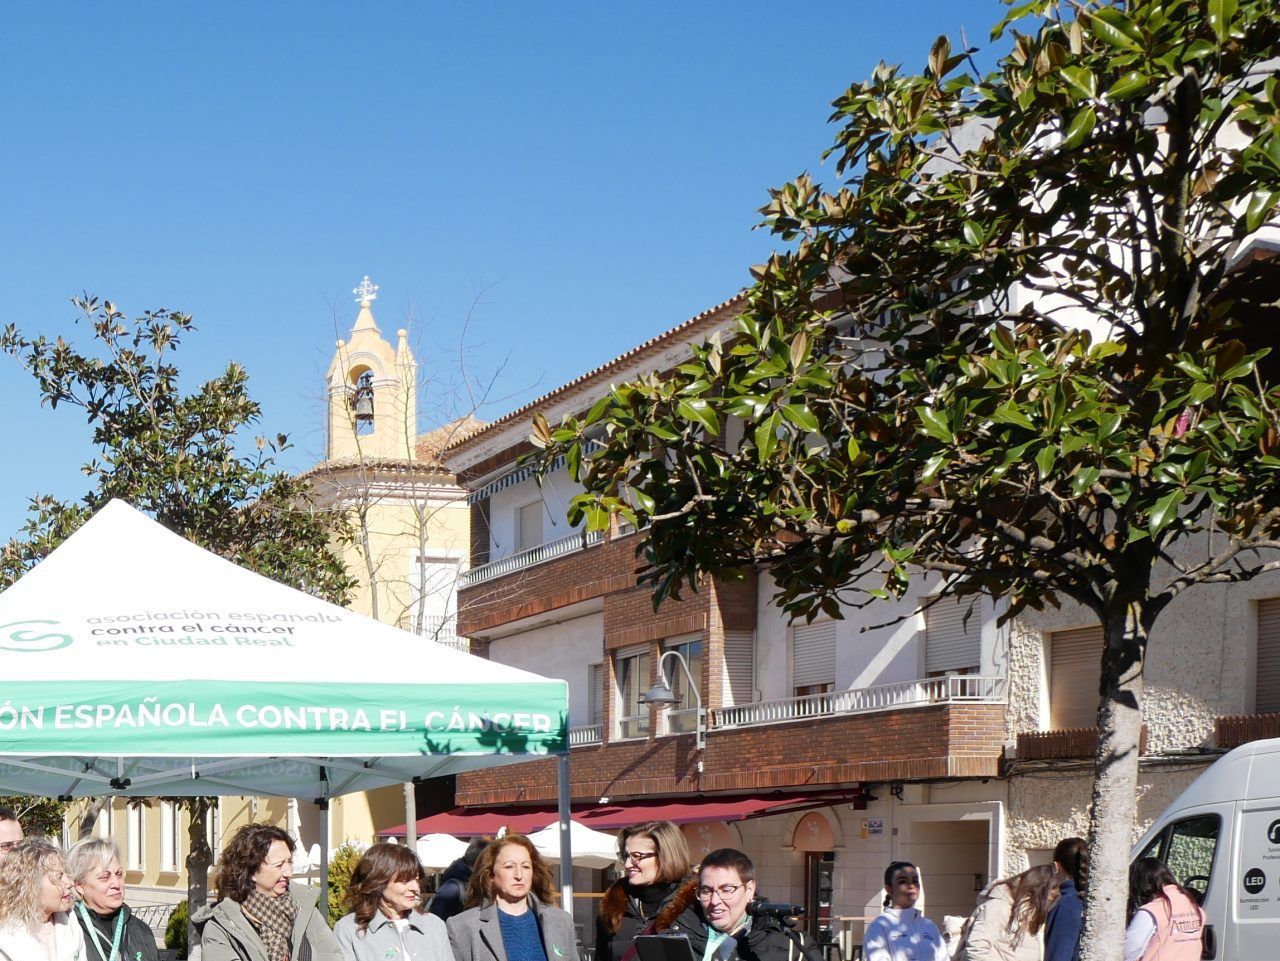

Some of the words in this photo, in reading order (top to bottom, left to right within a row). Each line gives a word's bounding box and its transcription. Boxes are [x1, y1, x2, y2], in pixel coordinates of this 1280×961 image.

[86, 610, 221, 625] asociación
[91, 624, 174, 636] contra
[181, 622, 203, 633] el
[210, 623, 296, 635] cáncer
[135, 636, 232, 646] Ciudad
[234, 637, 294, 646] Real
[54, 697, 231, 729] ESPAÑOLA
[236, 704, 372, 732] CONTRA
[379, 709, 416, 732] EL
[424, 705, 552, 733] CÁNCER
[1245, 876, 1264, 886] LED
